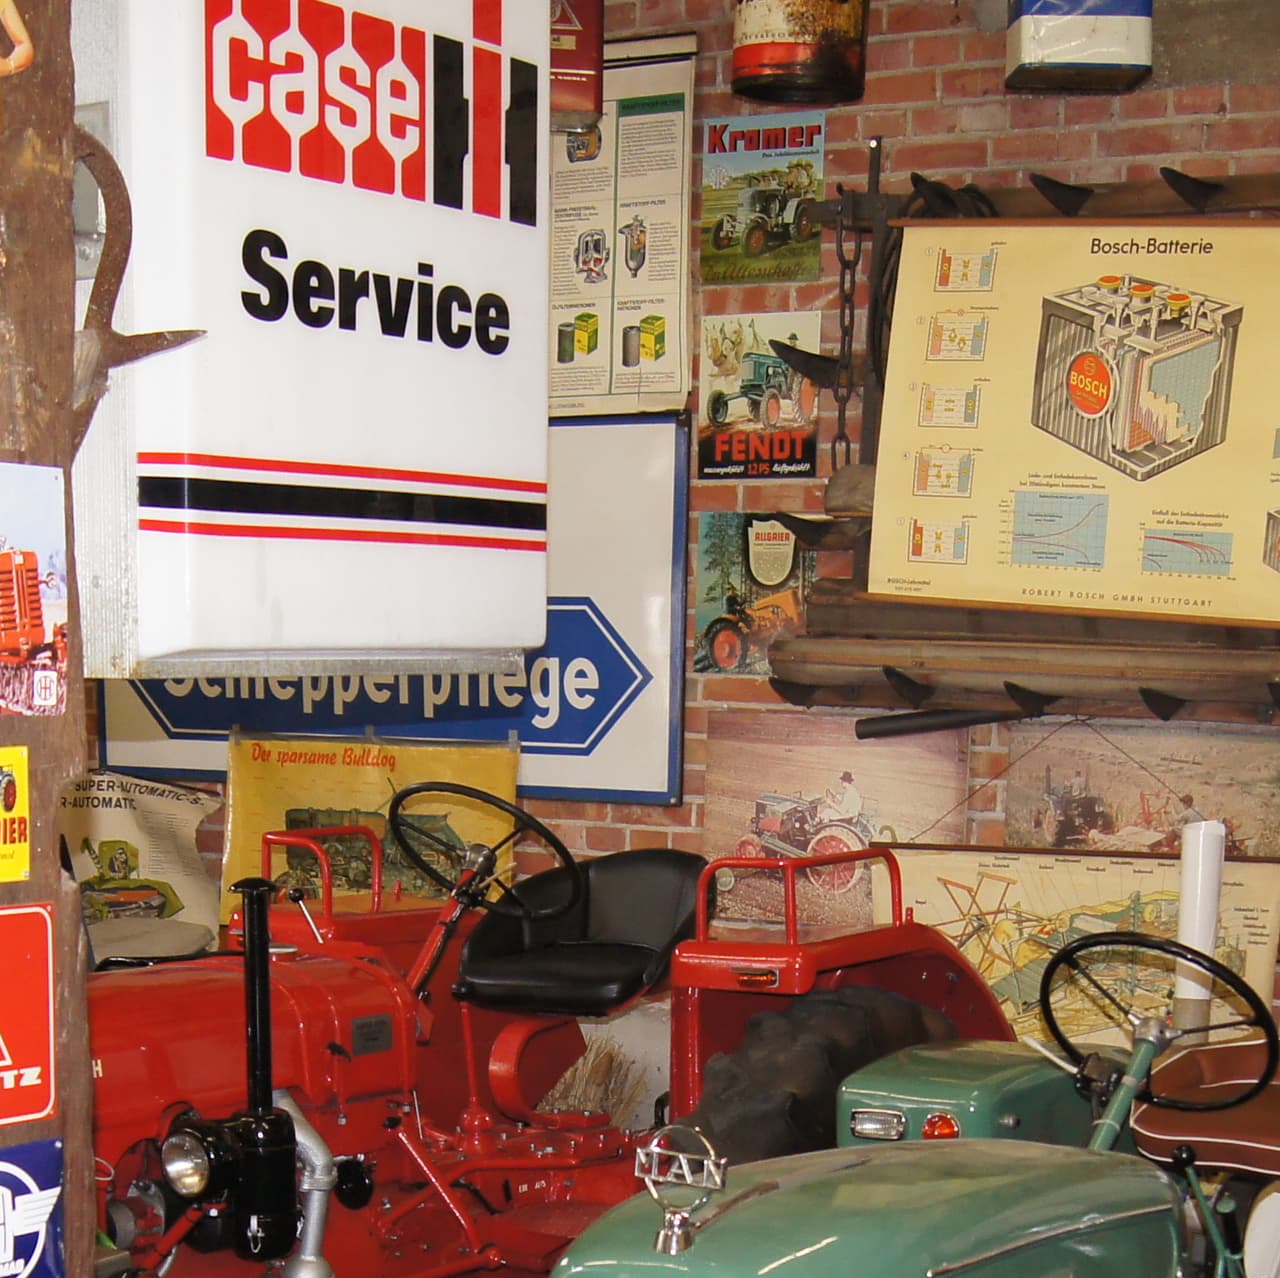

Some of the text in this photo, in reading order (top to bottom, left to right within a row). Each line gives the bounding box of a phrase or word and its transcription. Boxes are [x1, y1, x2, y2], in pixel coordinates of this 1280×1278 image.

[708, 123, 822, 154] Kramer
[1090, 237, 1214, 256] Bosch-Batterie
[241, 228, 511, 356] Service
[1069, 371, 1109, 400] BOSCH
[715, 431, 808, 462] FENDT
[755, 532, 790, 542] ALLGAIER
[1022, 588, 1213, 608] ROBERT BOSCH GMBH STUTTGART
[251, 743, 396, 771] Der sparsame Bulldog
